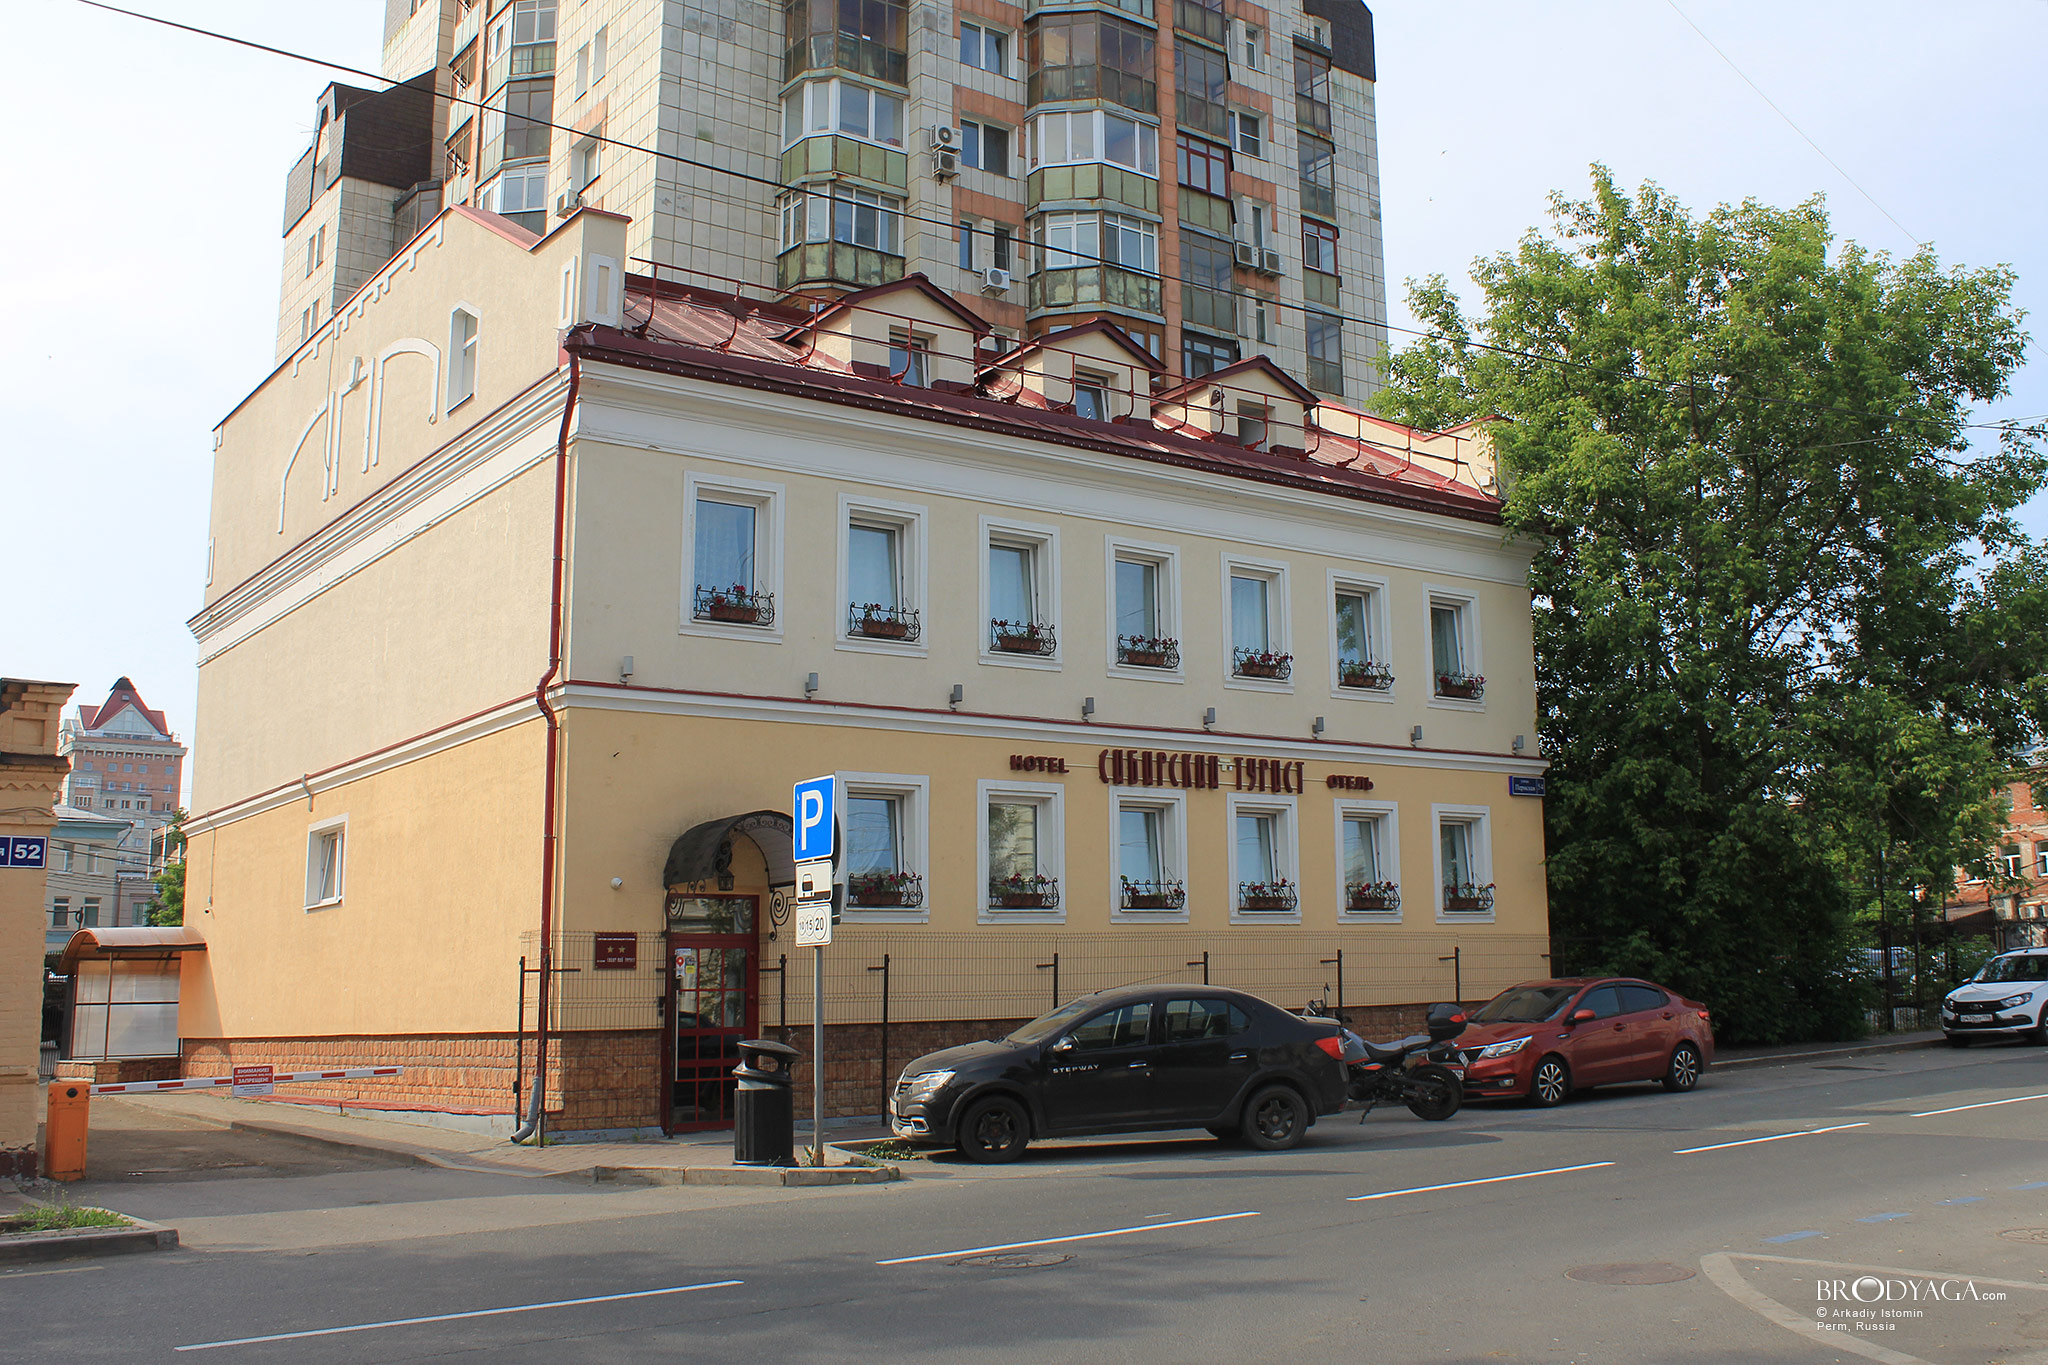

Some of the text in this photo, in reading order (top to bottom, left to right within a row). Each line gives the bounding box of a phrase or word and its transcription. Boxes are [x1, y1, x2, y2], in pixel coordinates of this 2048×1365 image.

[1010, 755, 1070, 774] HOTEL
[1233, 757, 1304, 794] ТУРИСТ
[1326, 774, 1374, 791] ОТЕЛЬ
[801, 789, 824, 851] P
[14, 844, 41, 860] 52
[806, 919, 813, 931] 15
[815, 917, 824, 931] 20
[1052, 1064, 1099, 1074] STEPWAY
